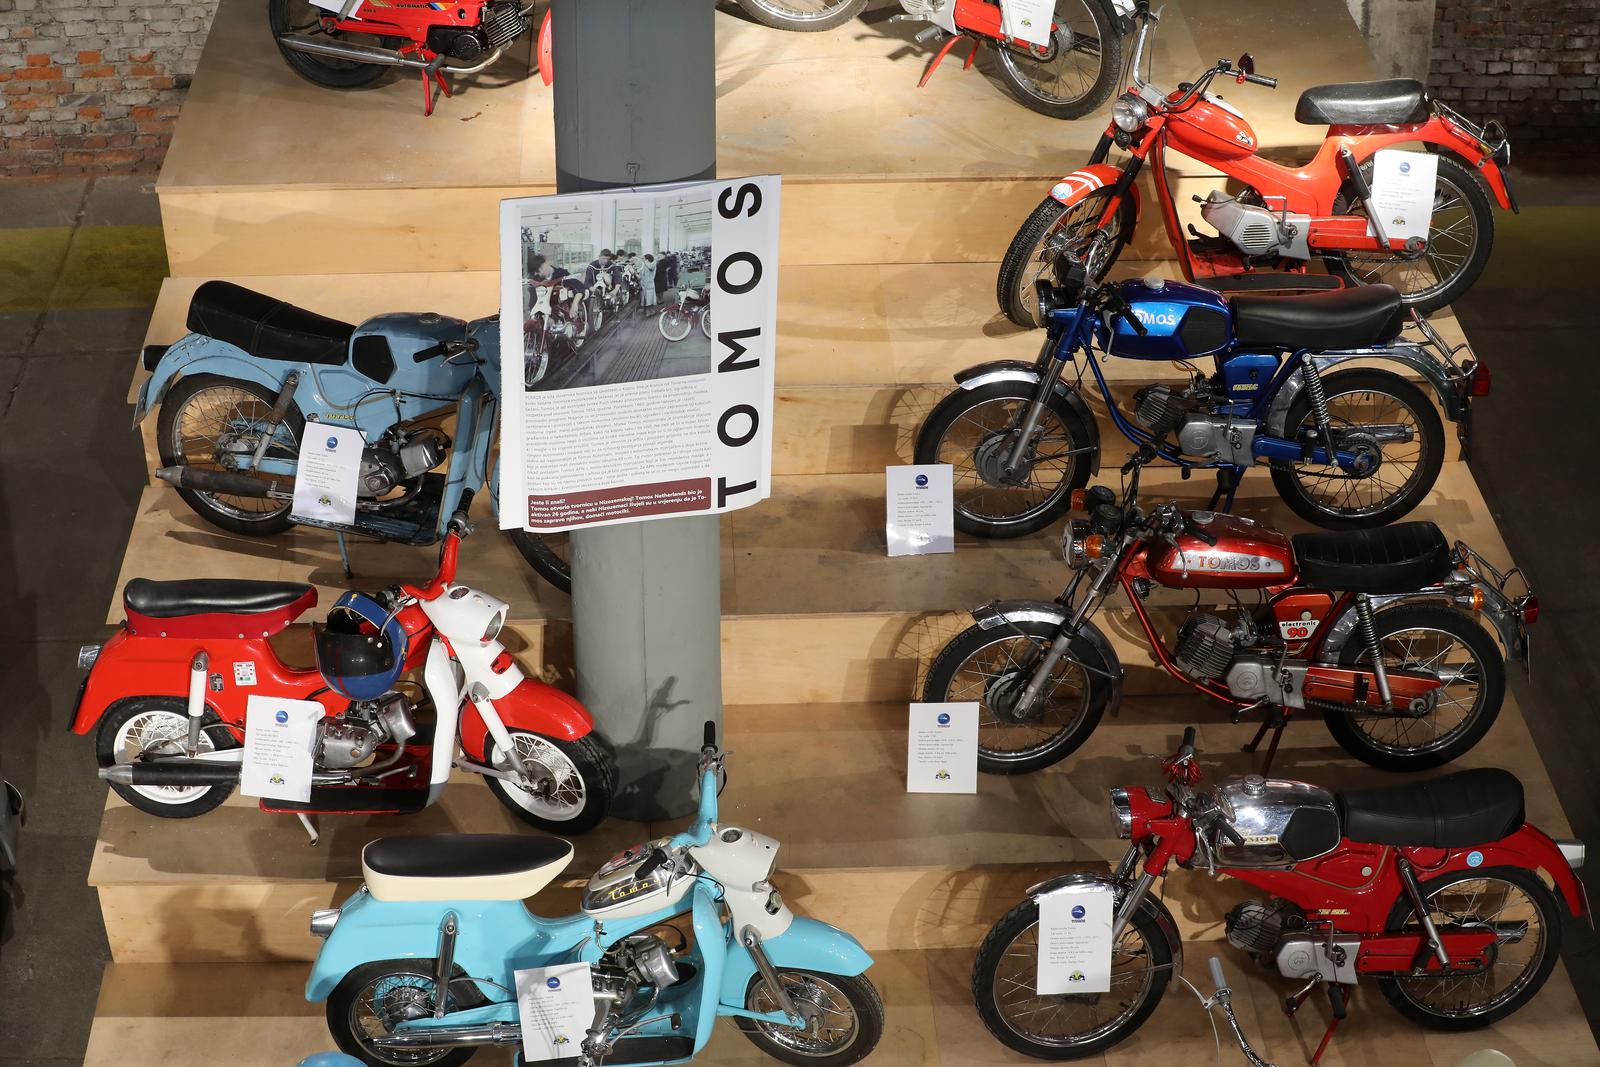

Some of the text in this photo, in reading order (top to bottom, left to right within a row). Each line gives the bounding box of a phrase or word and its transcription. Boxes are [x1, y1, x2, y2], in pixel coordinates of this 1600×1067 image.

[717, 183, 762, 507] TOMOS
[654, 491, 686, 499] Netherlands
[657, 497, 683, 505] uvjerenju
[543, 517, 566, 525] zapravo
[1199, 556, 1260, 571] TOMOS
[1287, 627, 1308, 638] 90
